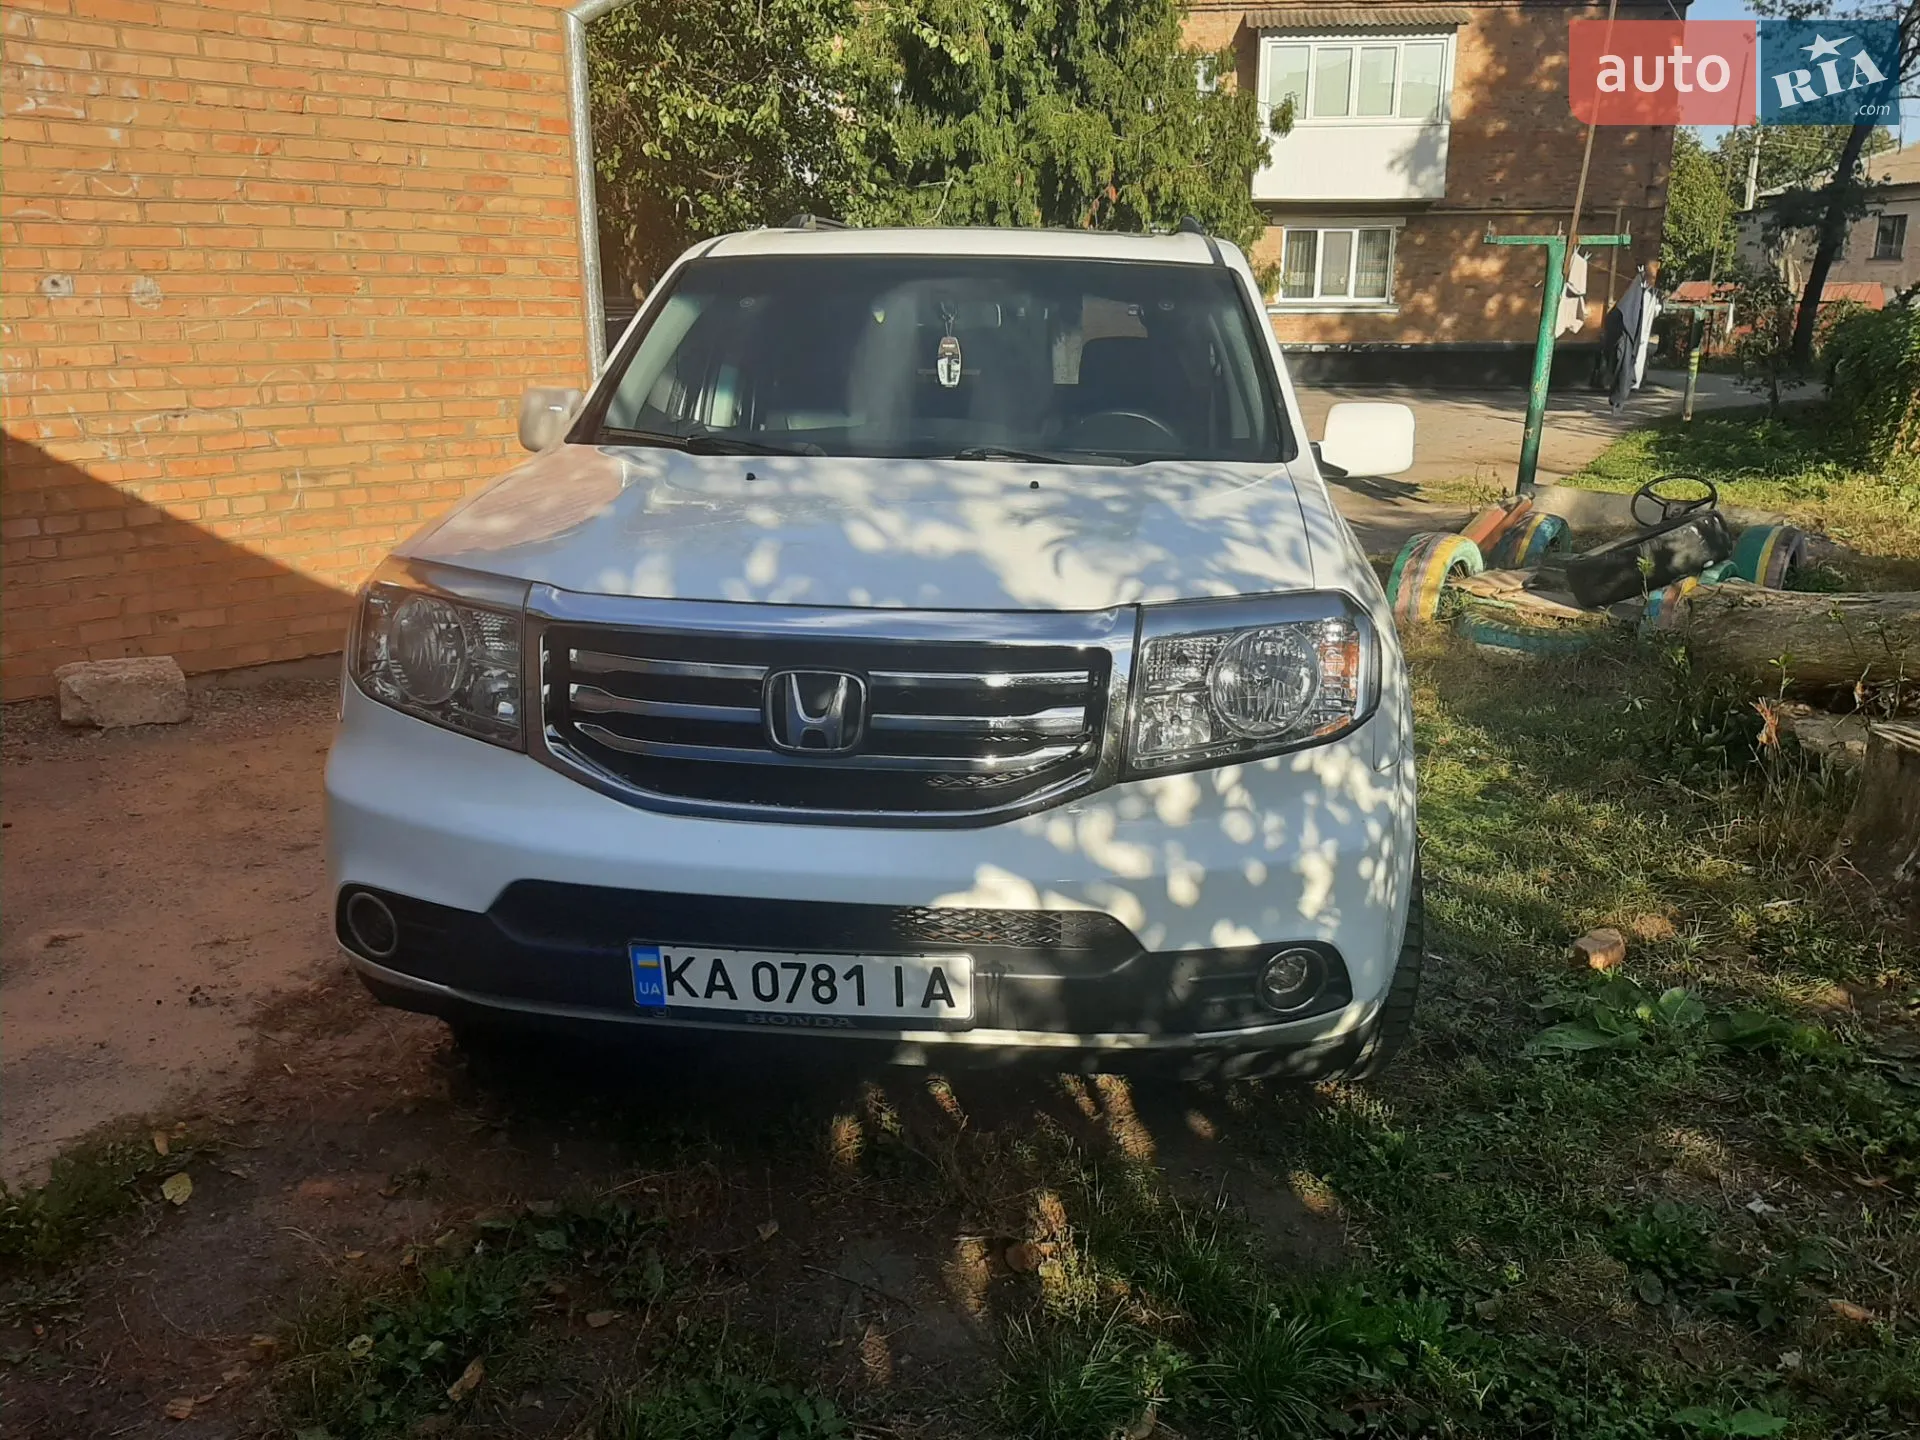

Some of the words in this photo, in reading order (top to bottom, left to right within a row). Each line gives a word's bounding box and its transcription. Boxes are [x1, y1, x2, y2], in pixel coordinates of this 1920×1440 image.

[640, 982, 661, 995] UA
[663, 954, 739, 1001] KA
[751, 960, 867, 1007] 0781
[746, 1012, 858, 1029] HONDA
